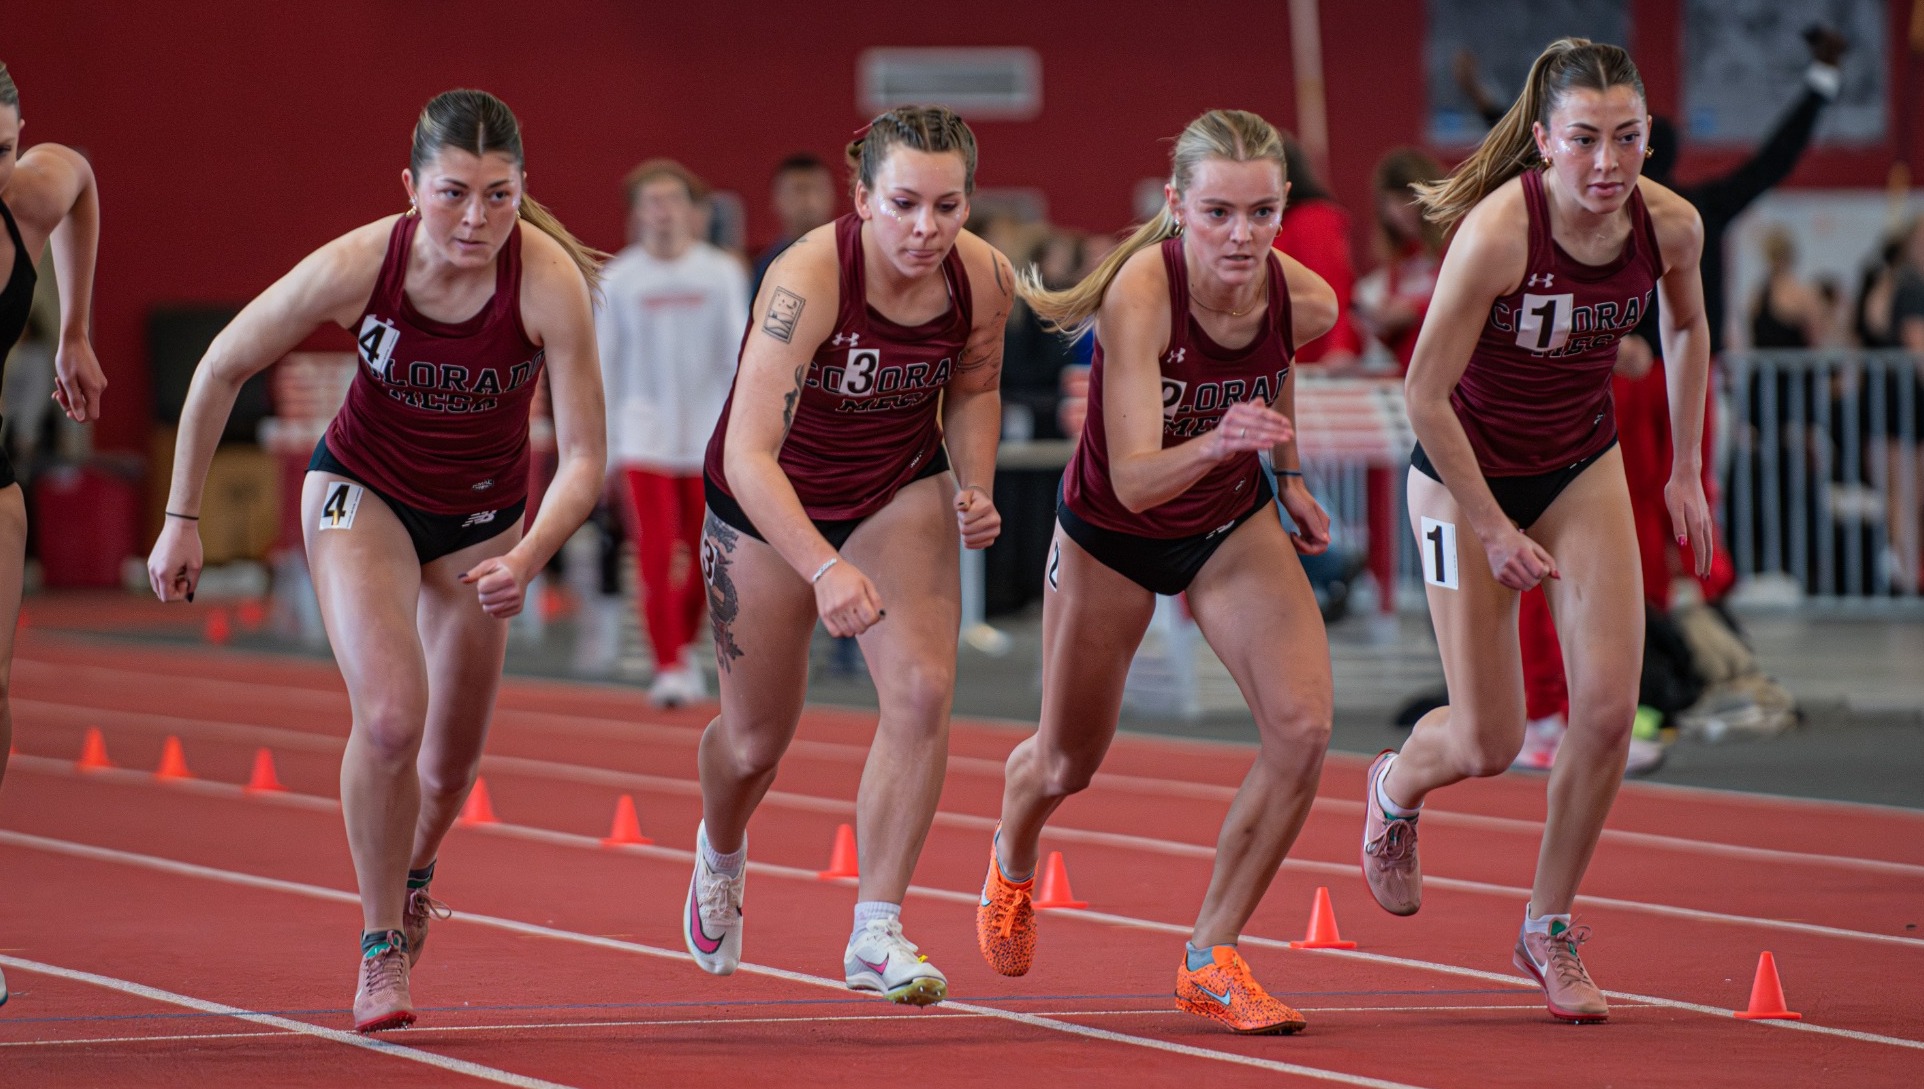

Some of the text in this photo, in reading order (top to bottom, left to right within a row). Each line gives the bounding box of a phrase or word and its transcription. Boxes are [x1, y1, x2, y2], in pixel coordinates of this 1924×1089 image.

[359, 325, 387, 364] 4
[1531, 300, 1557, 348] 1
[847, 352, 877, 394] 3
[323, 484, 350, 525] 4
[703, 539, 715, 580] 3
[1427, 525, 1446, 583] 1
